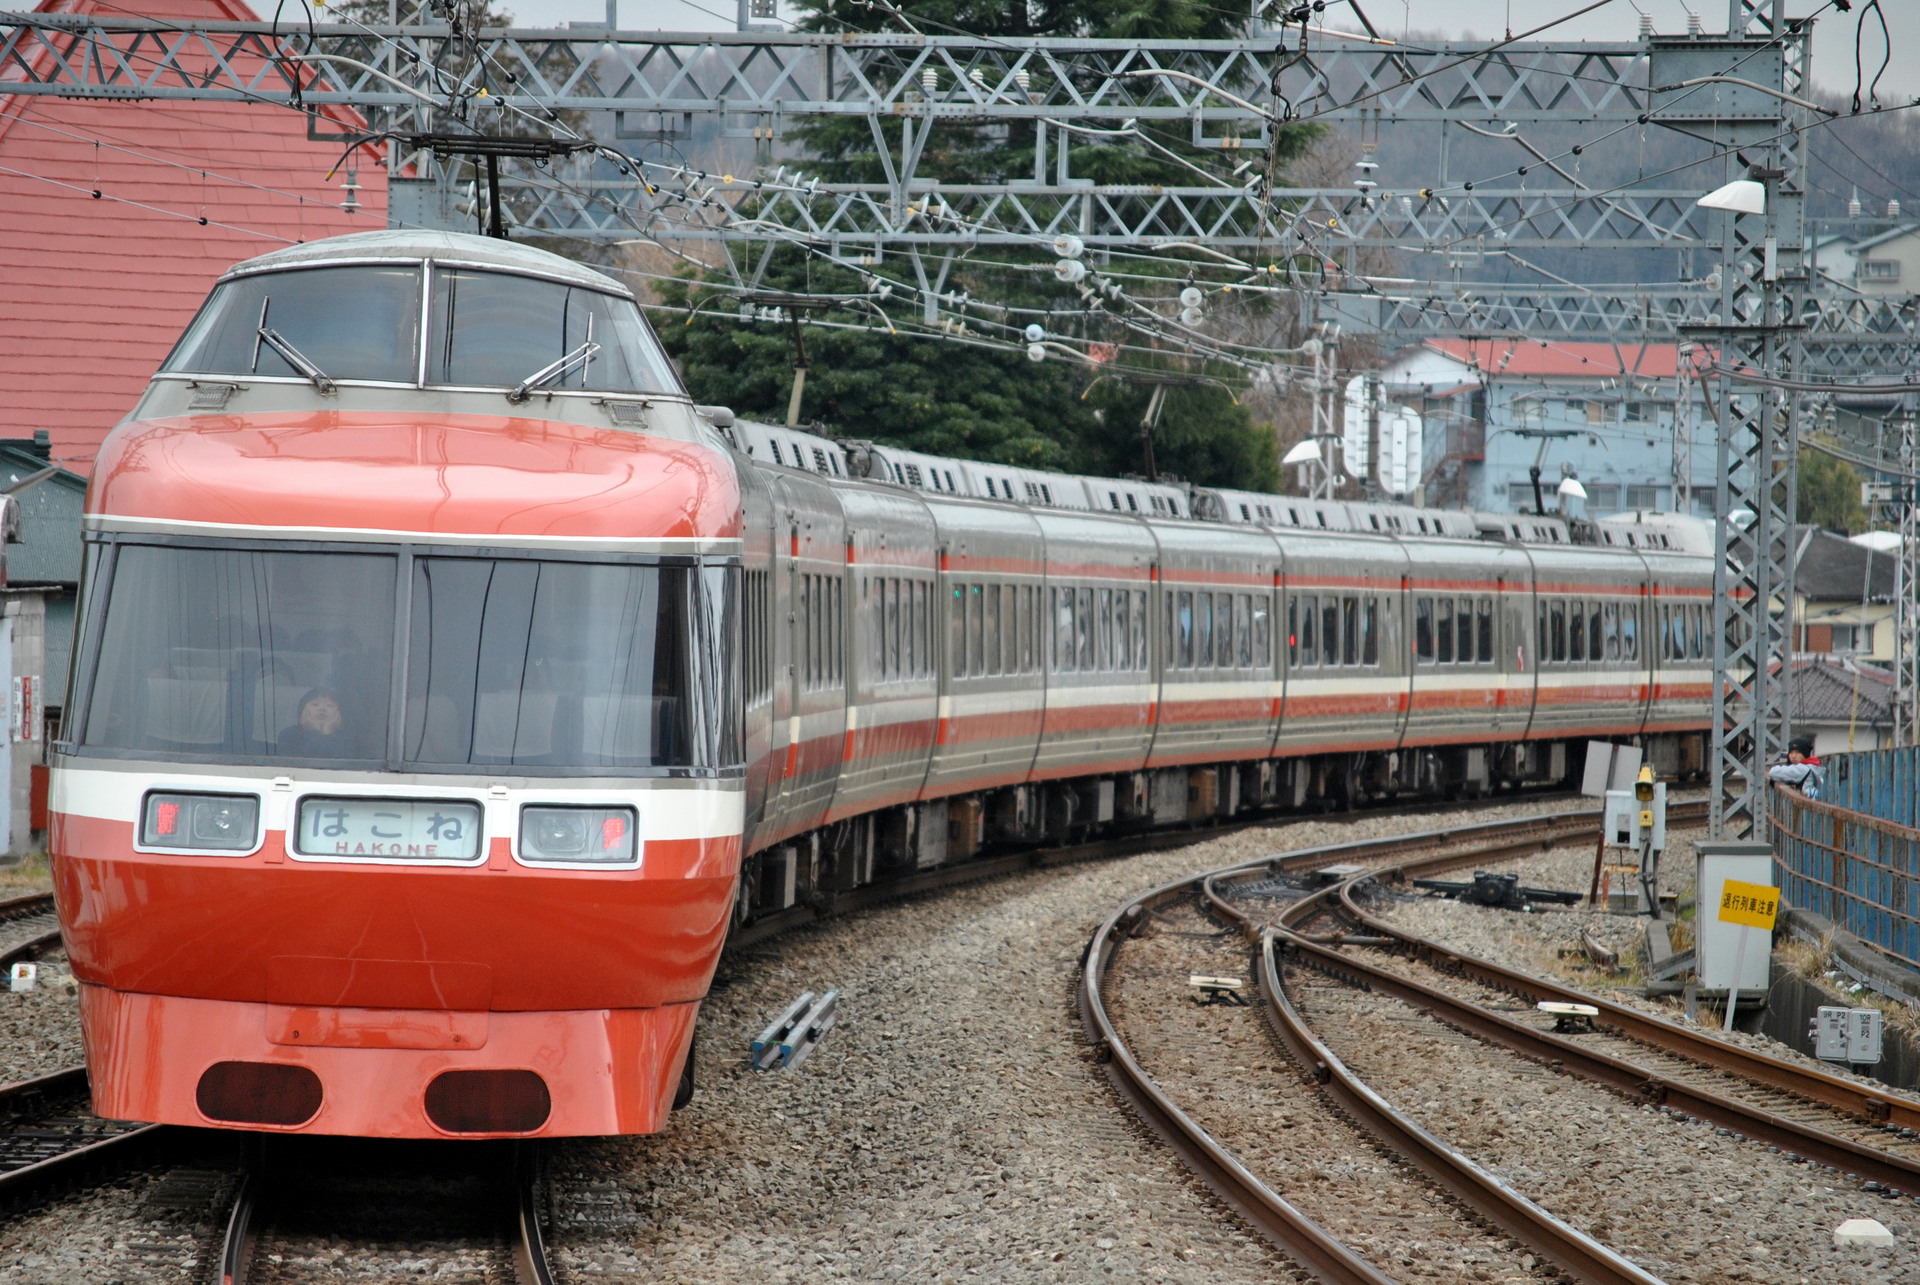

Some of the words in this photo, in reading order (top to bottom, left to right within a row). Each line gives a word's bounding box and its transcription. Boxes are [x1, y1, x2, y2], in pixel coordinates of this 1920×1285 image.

[312, 808, 463, 841] はこね
[335, 841, 438, 857] HAKONE
[1836, 1011, 1846, 1019] P2
[1861, 1030, 1870, 1038] P2
